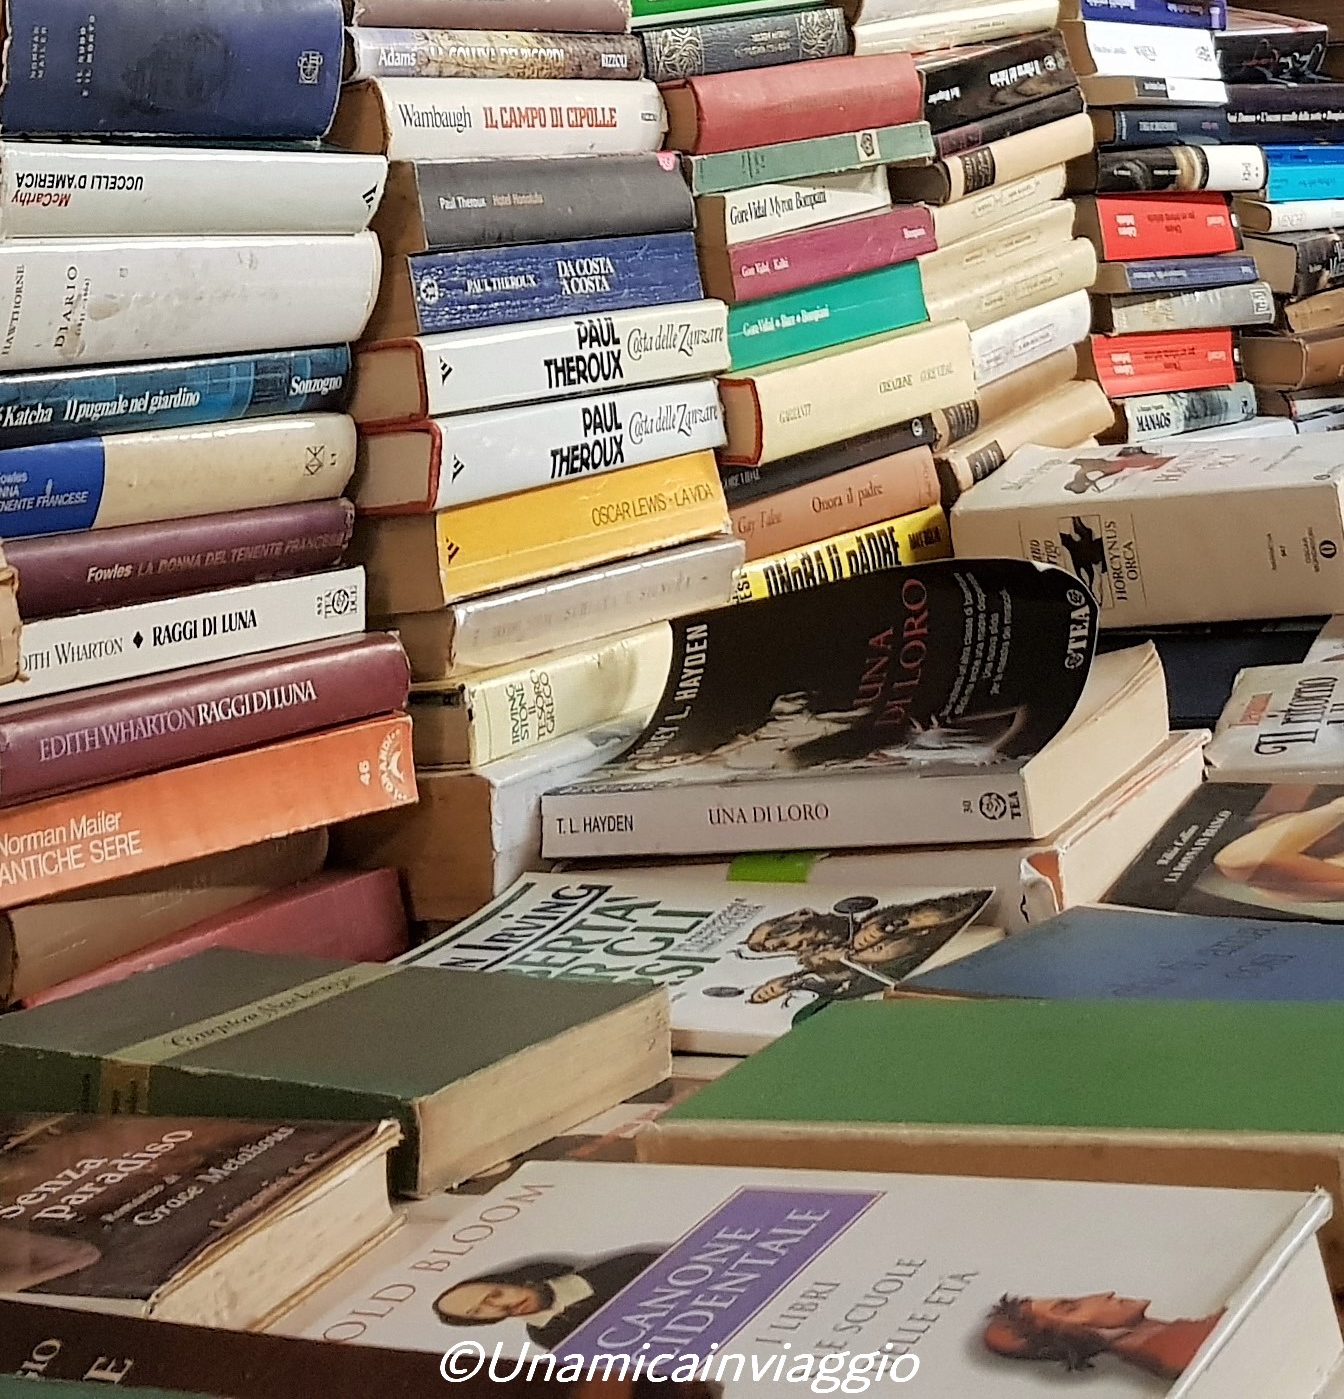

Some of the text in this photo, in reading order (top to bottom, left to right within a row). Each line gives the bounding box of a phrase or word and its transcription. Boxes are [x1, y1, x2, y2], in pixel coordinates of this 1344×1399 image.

[398, 104, 617, 132] Wambaugh IL CAMPO DI CIPOLLE
[12, 189, 70, 208] McCarthy
[16, 172, 144, 191] UCCELLI D'AMERICA
[54, 264, 79, 349] DIARIO
[576, 317, 620, 349] PAUL
[627, 327, 653, 362] Costa
[677, 323, 724, 355] Zanzare
[544, 349, 623, 389] THEROUX
[152, 620, 198, 647] RAGGI
[202, 616, 217, 638] DI
[221, 610, 257, 633] LUNA
[1068, 600, 1092, 655] TEA
[70, 811, 122, 839] Mailer
[708, 803, 829, 825] UNA DI LORO
[90, 831, 142, 863] SERE
[34, 1127, 194, 1222] paradiso
[131, 1182, 204, 1228] Grace
[409, 1179, 558, 1273] BLOOM
